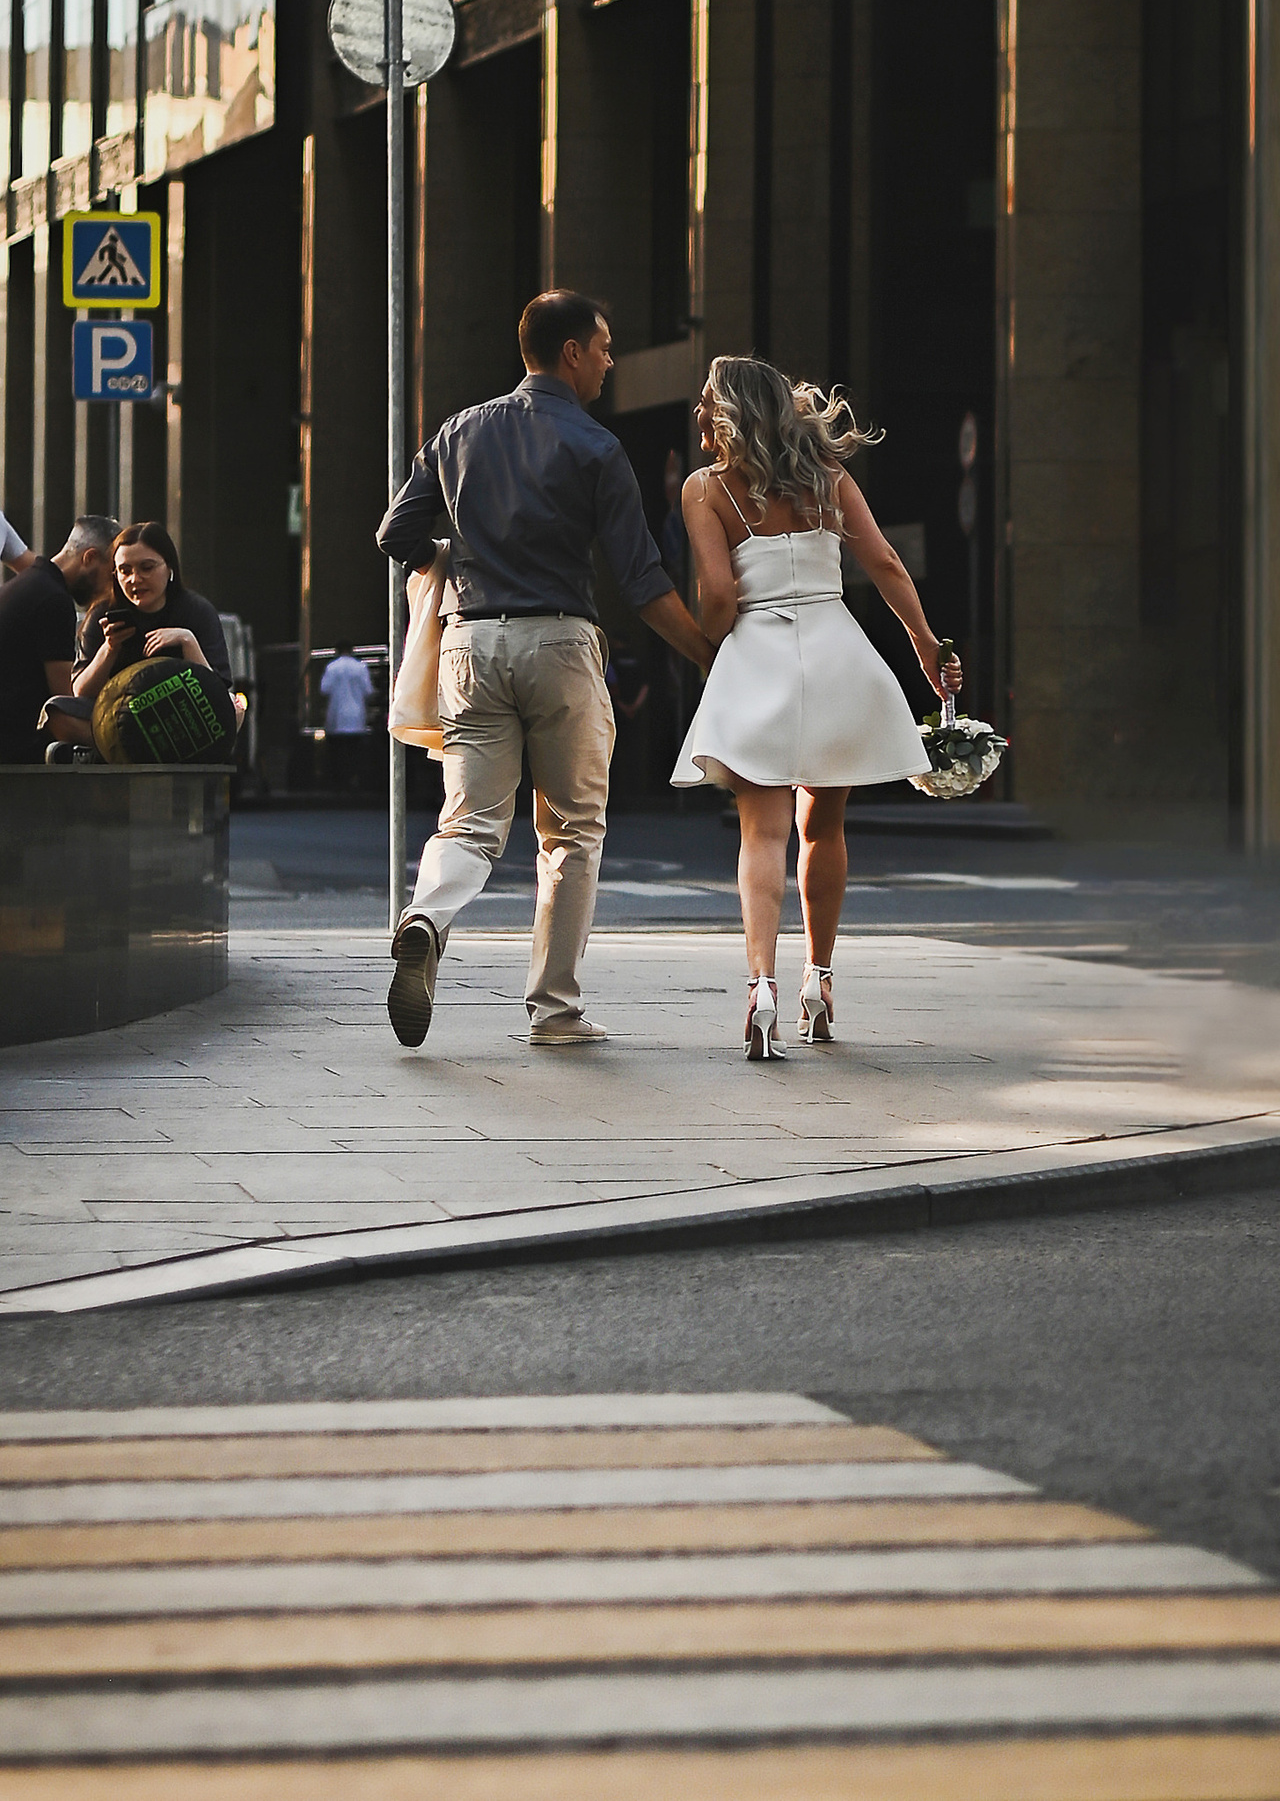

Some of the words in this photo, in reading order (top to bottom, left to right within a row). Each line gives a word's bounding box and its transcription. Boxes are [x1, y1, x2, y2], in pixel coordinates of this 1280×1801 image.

[92, 327, 137, 393] P
[133, 693, 155, 711] 800
[155, 679, 180, 698] FILL
[180, 668, 226, 740] Marmot
